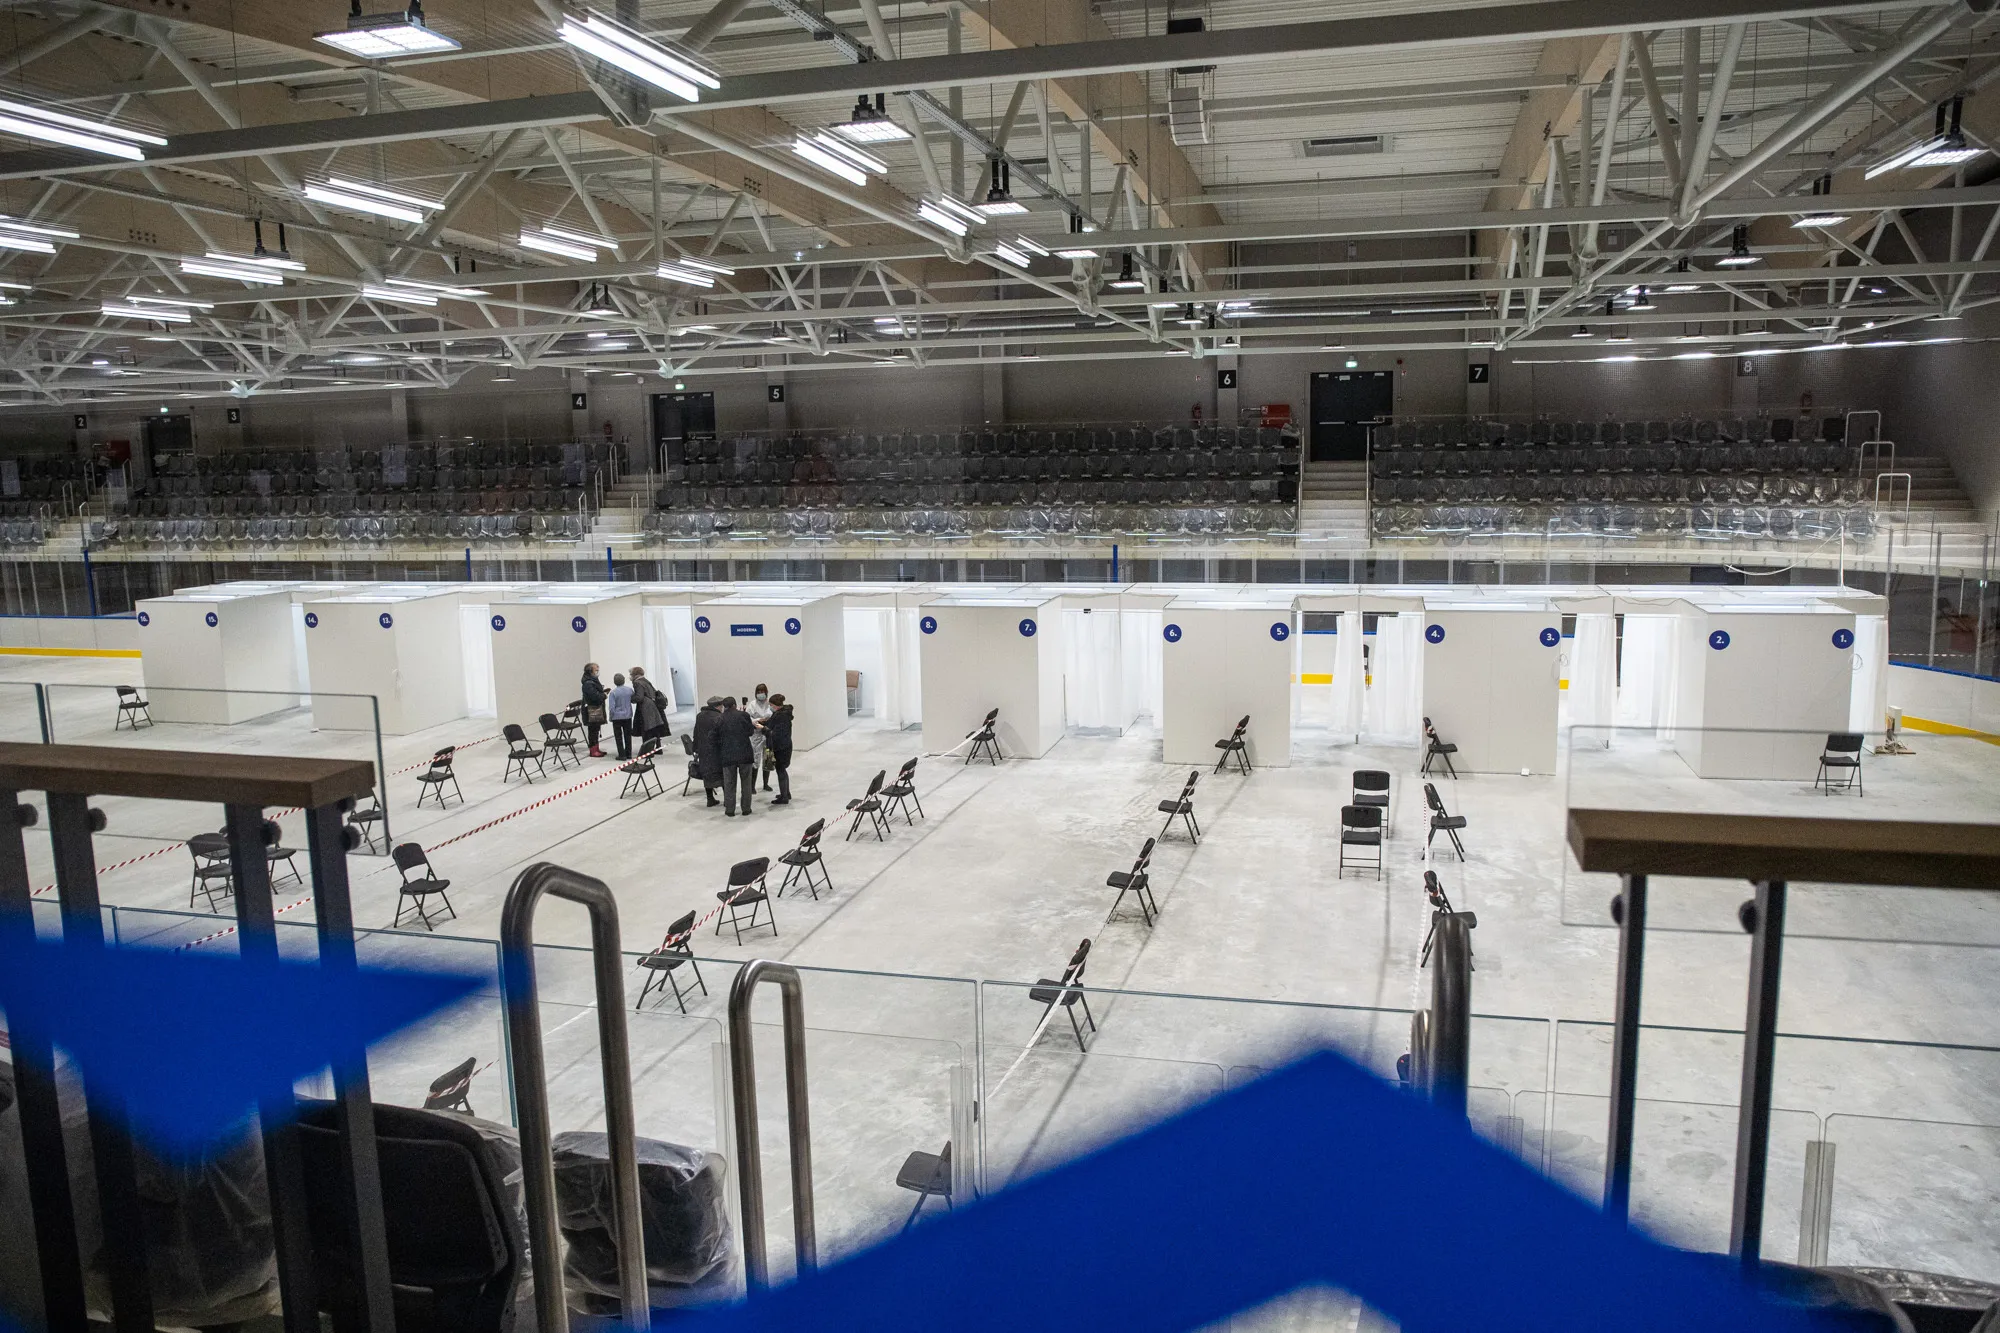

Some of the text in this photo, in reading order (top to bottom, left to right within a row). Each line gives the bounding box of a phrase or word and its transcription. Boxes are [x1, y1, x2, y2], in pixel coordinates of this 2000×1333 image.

[1475, 368, 1482, 379] 7
[1224, 374, 1231, 385] 6
[773, 388, 779, 399] 5
[576, 396, 582, 406] 4
[231, 412, 236, 421] 3
[78, 417, 84, 427] 2
[925, 621, 933, 629] 8.
[1025, 623, 1032, 631] 7.
[1169, 629, 1177, 637] 6.
[1276, 627, 1284, 636] 5.
[1431, 630, 1440, 638] 4.
[1546, 633, 1554, 641] 3.
[1716, 635, 1724, 644] 2.
[1840, 634, 1847, 643] 1.
